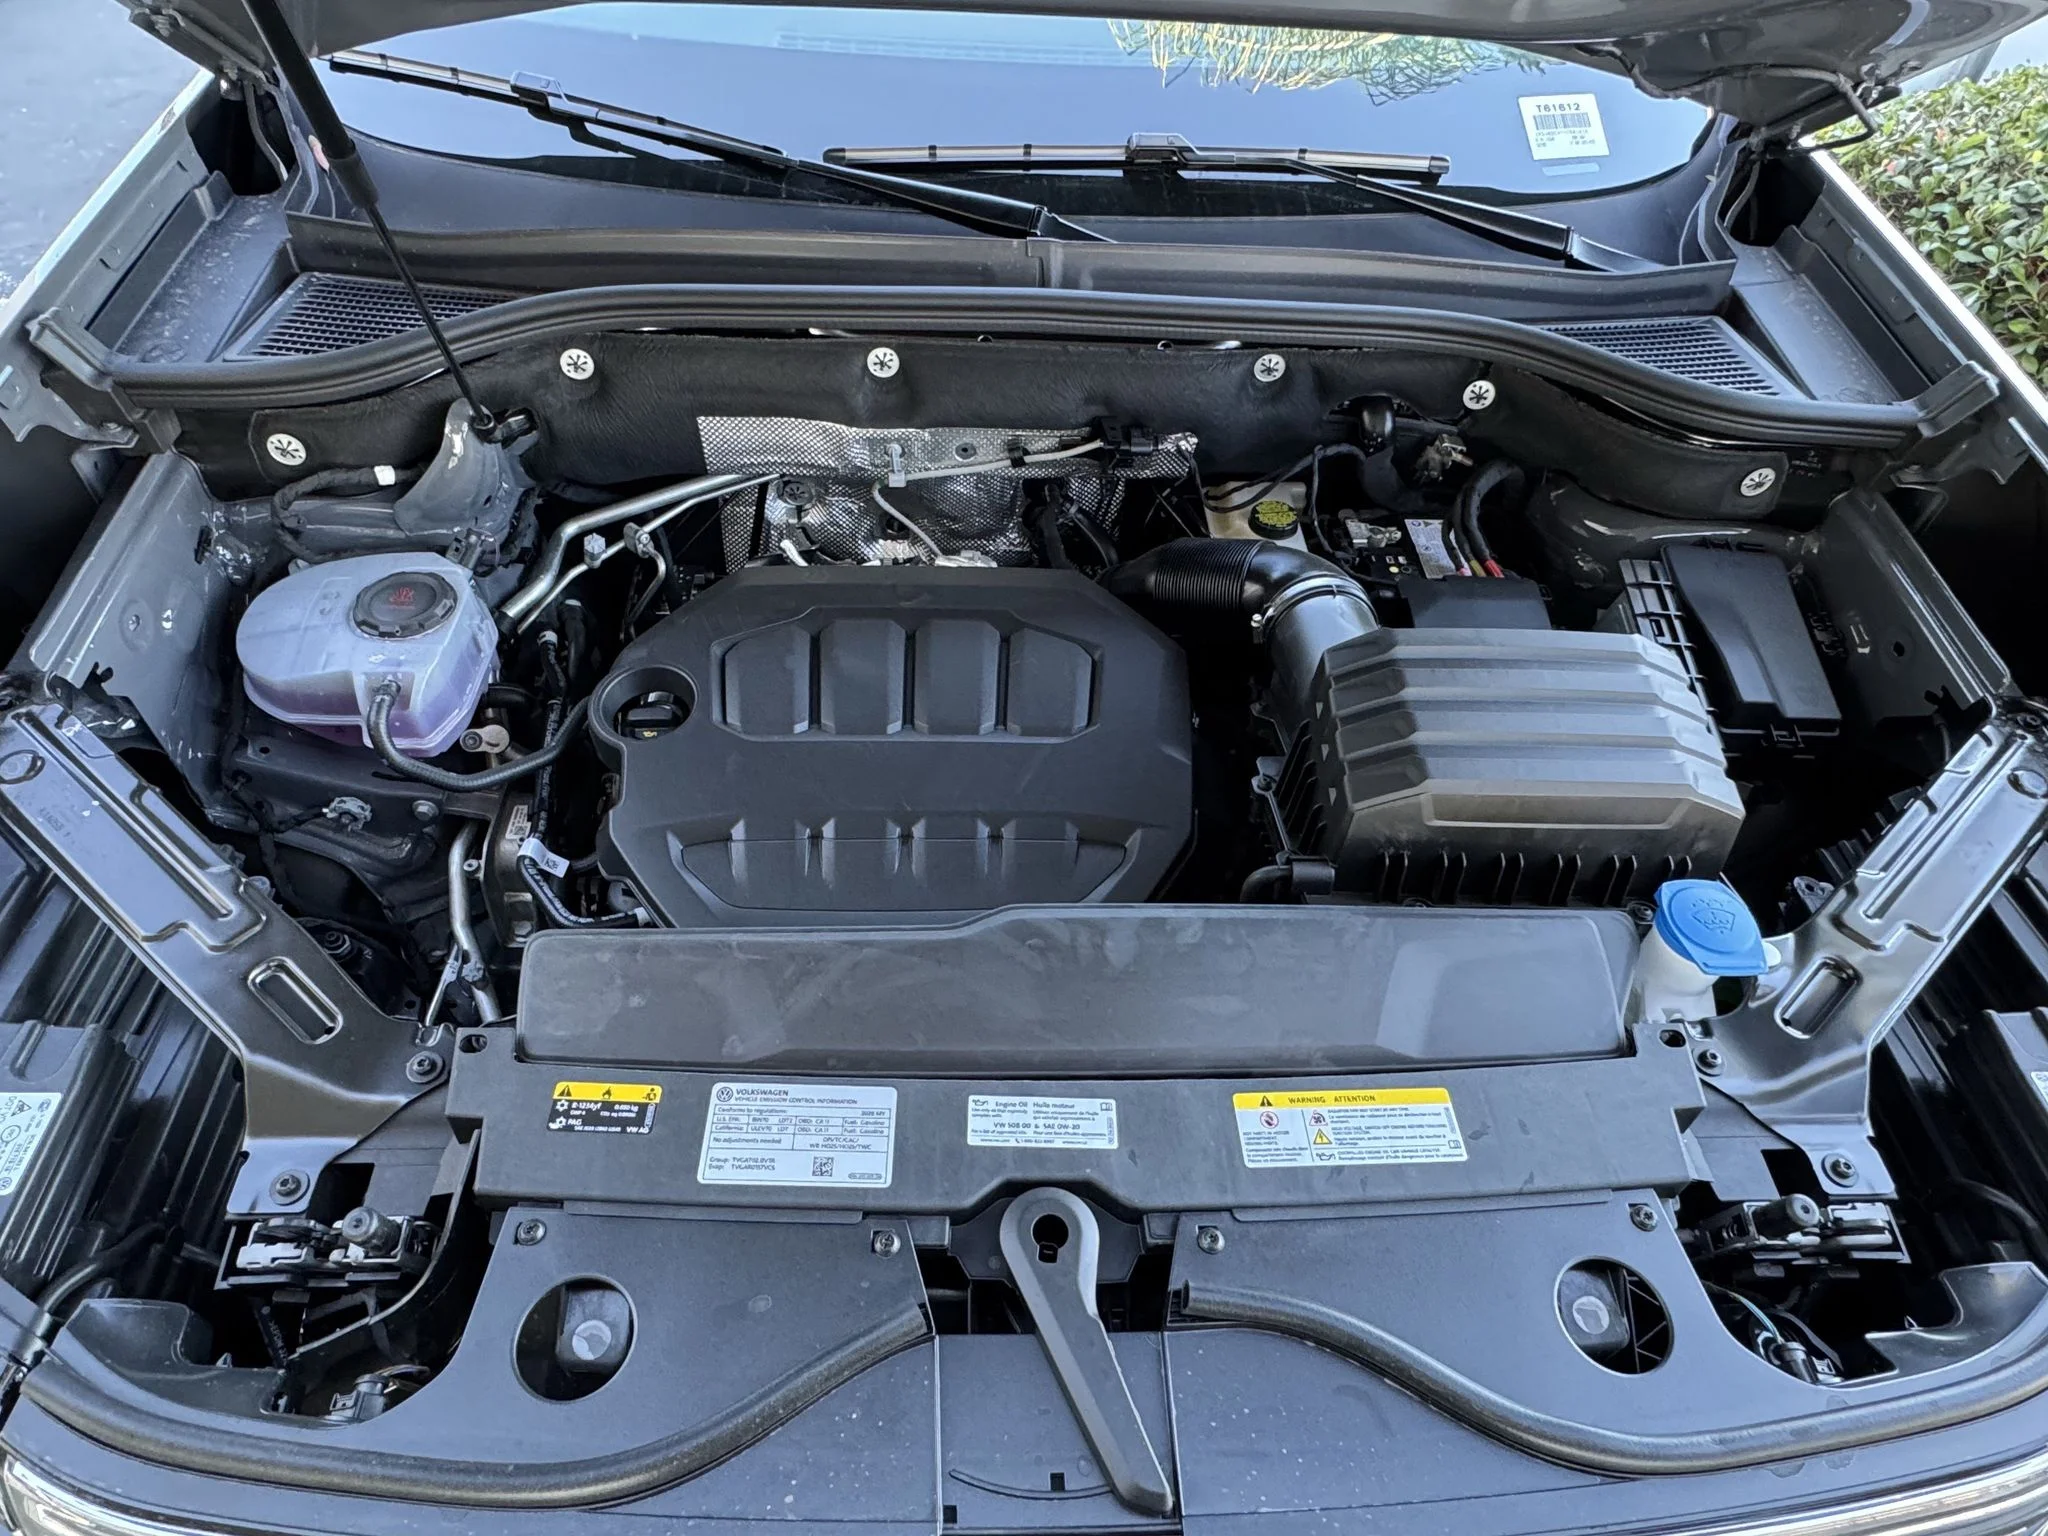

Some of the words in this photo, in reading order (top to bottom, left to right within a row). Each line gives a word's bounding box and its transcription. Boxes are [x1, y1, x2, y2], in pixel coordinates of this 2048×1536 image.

[1536, 103, 1580, 112] T61612
[736, 1088, 789, 1096] VOLKSWAGEN
[1288, 1096, 1326, 1104] WARNING
[1334, 1095, 1376, 1103] ATTENTION
